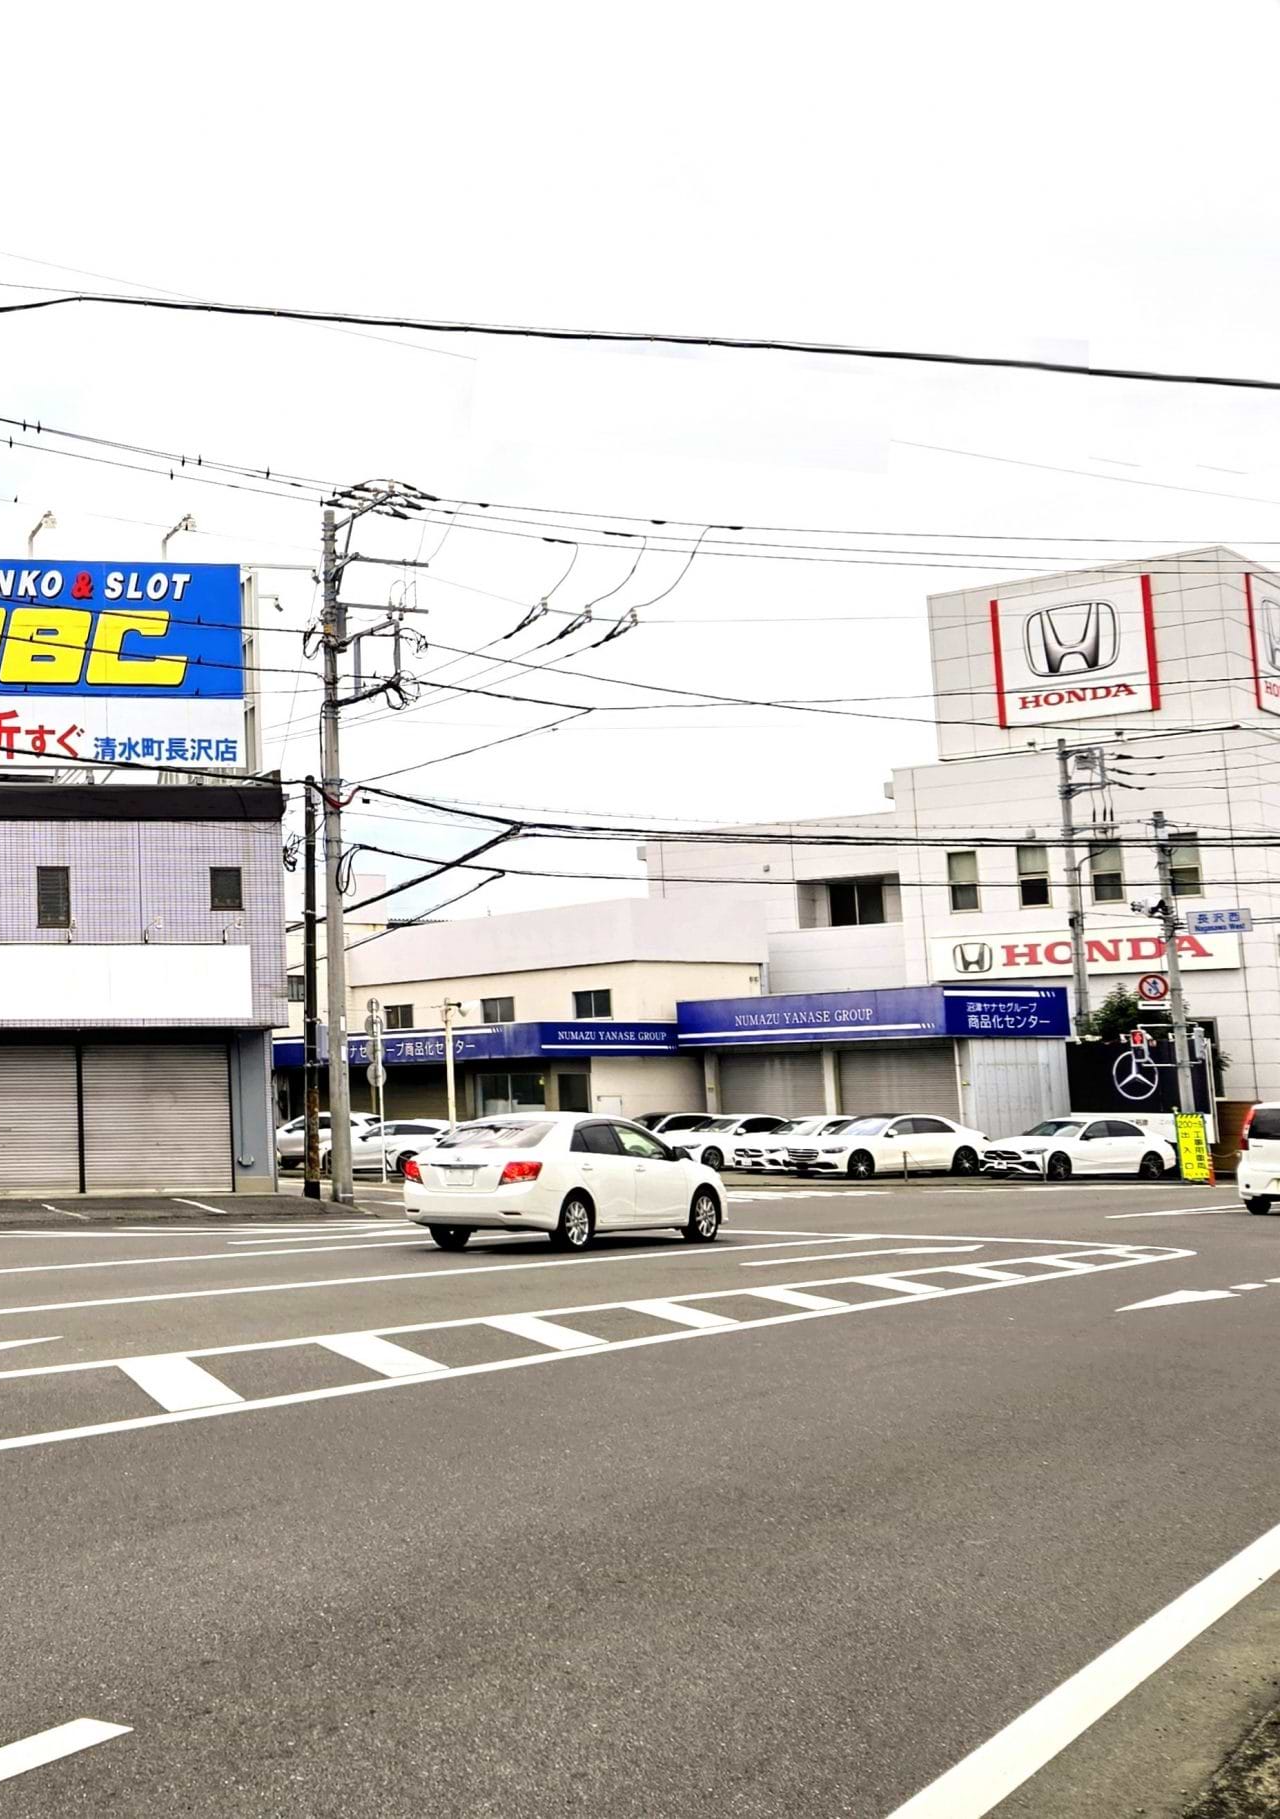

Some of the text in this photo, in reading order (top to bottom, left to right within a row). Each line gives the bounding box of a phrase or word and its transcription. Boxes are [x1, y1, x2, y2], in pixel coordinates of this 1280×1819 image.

[71, 571, 94, 600] &
[104, 572, 191, 602] SLOT
[1019, 683, 1137, 709] HONDA
[93, 736, 238, 762] 清水町長沢店
[1001, 935, 1213, 967] HONDA
[735, 1008, 873, 1027] NUMAZU YANASE GROUP
[967, 1014, 1051, 1029] 商品化センター
[558, 1031, 667, 1041] NUMAZU YANASE GROUP
